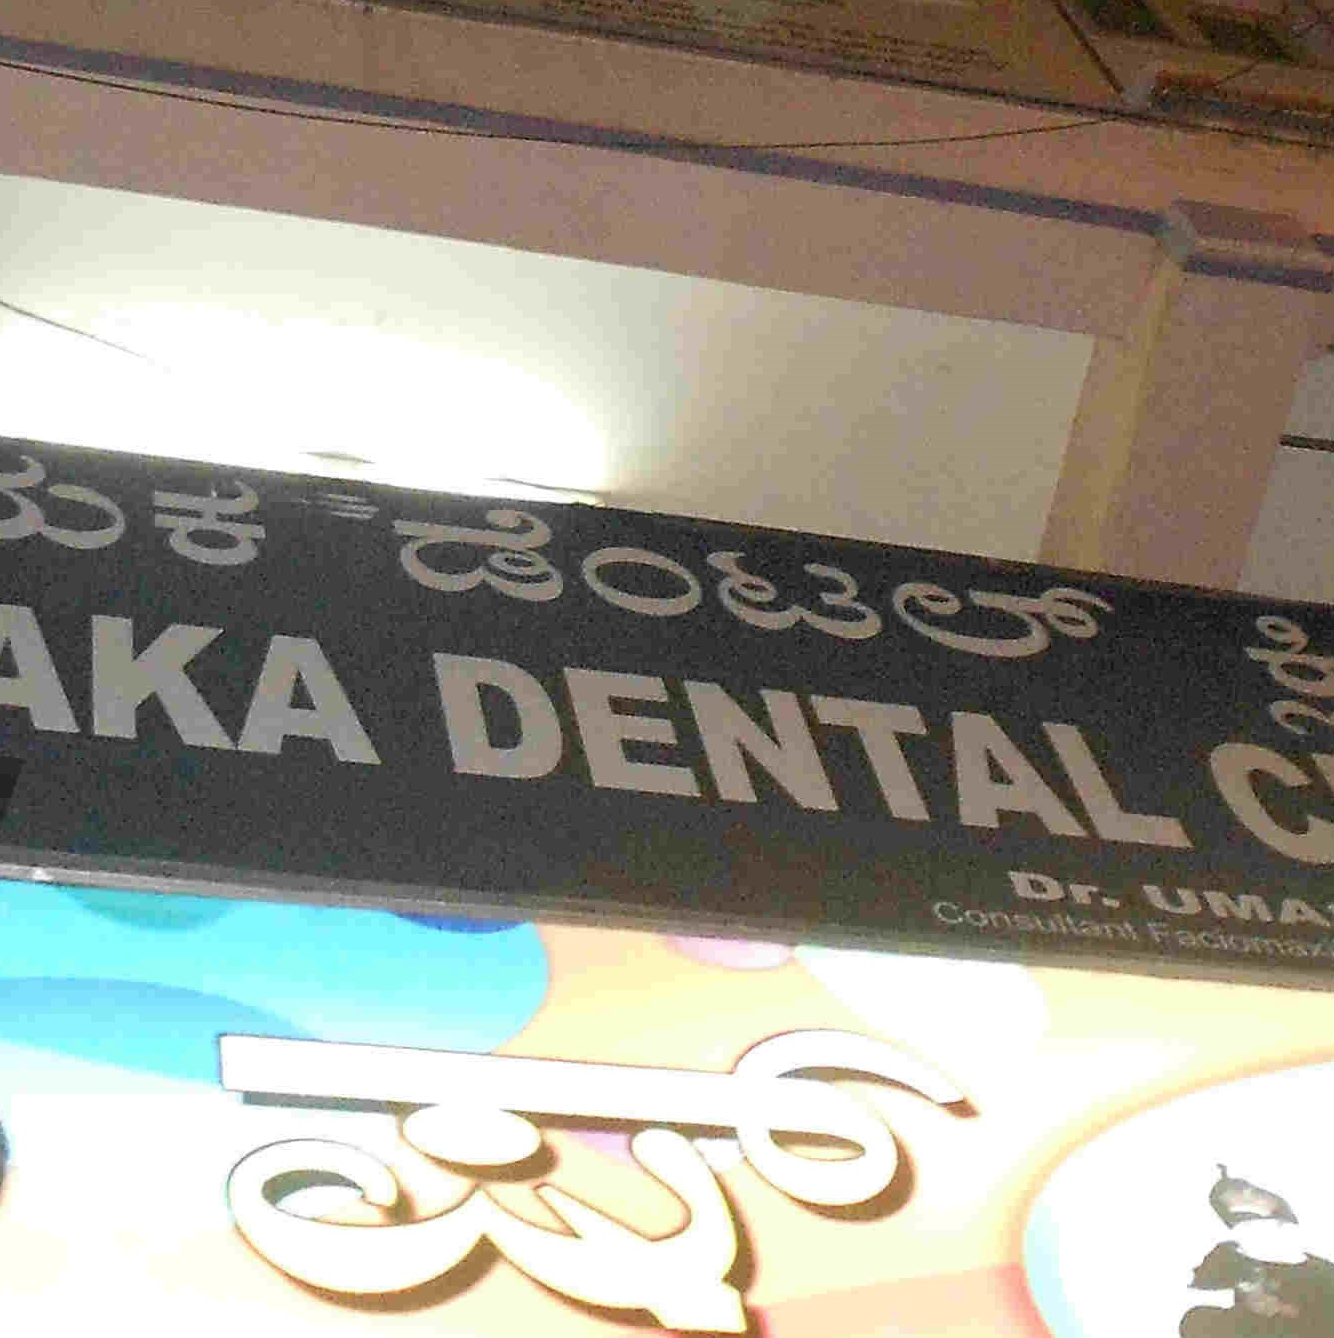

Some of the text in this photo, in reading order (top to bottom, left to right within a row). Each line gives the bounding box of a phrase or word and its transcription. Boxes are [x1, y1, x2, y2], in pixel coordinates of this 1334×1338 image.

[432, 650, 1192, 852] DENTAL
[1007, 869, 1121, 909] Dr.
[931, 899, 1139, 942] Consultant
